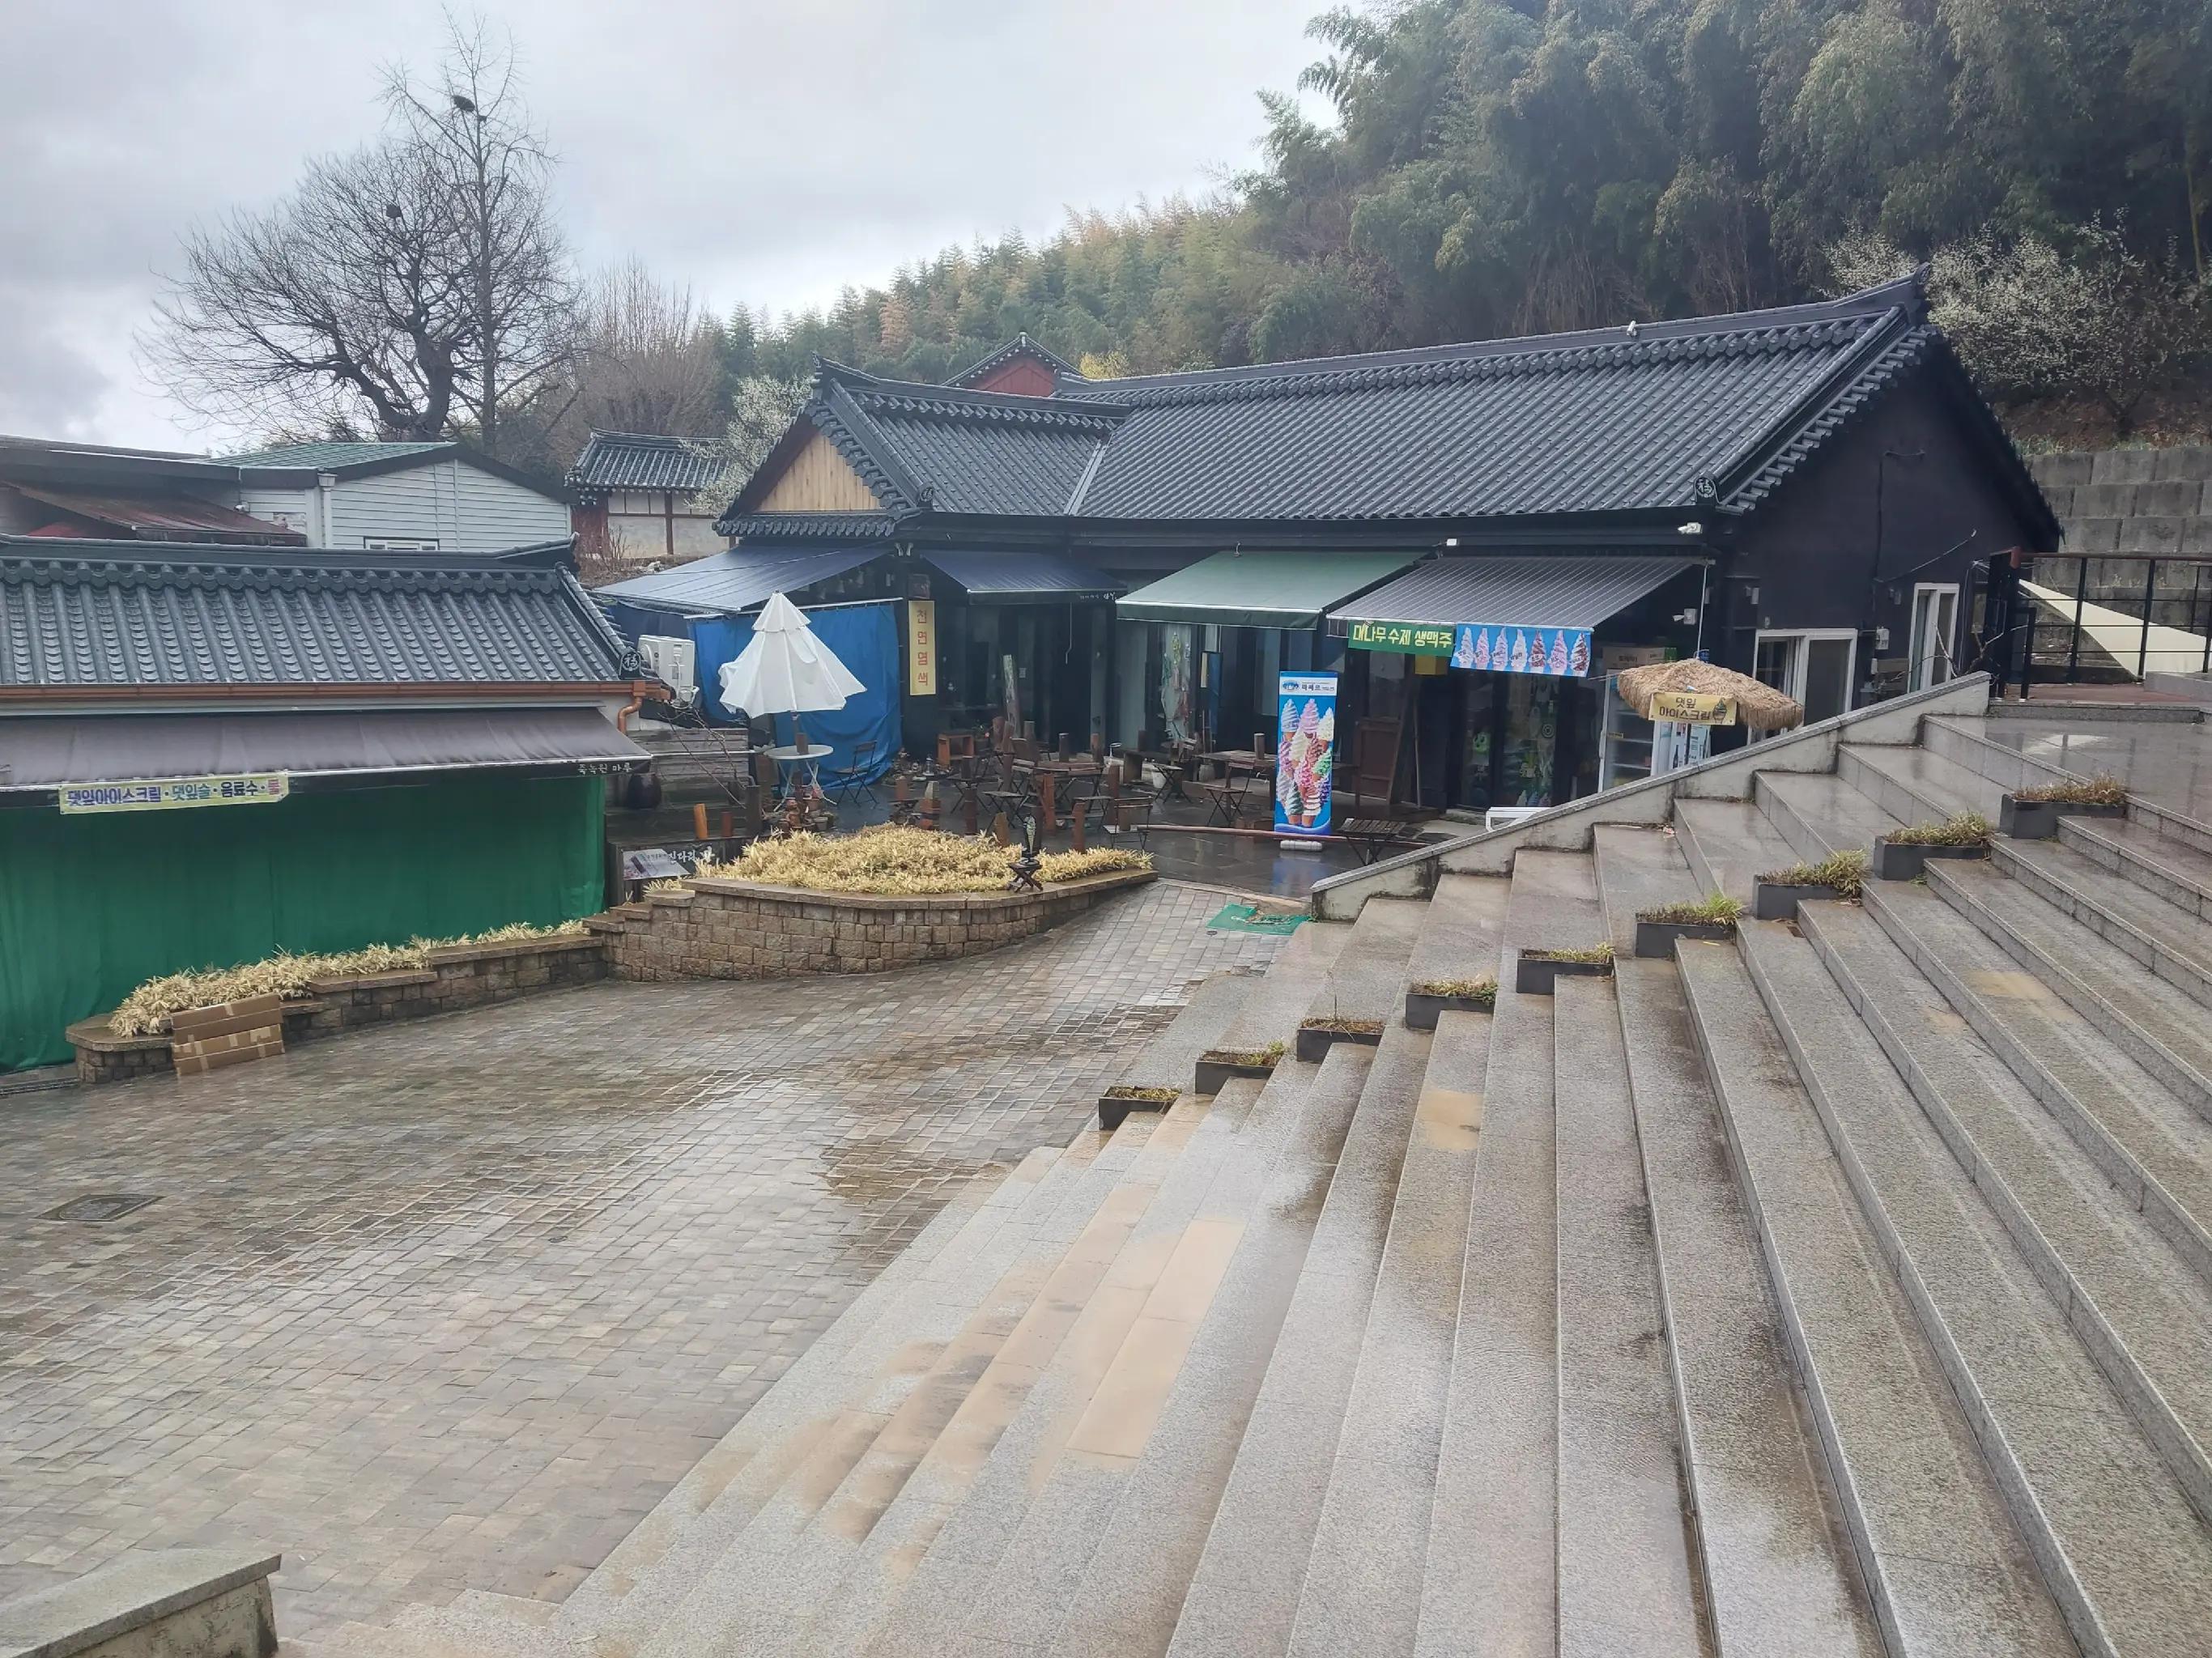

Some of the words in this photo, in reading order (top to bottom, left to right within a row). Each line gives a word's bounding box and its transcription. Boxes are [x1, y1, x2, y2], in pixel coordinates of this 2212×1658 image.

[1352, 623, 1387, 643] 대나무
[1387, 628, 1413, 646] 수제
[1414, 630, 1453, 648] 생맥주
[917, 609, 929, 687] 천연염색
[1675, 696, 1697, 709] 댓잎
[1659, 706, 1712, 721] 아이스크림
[577, 763, 608, 776] 죽녹원
[612, 762, 632, 773] 마루
[220, 780, 259, 798] 음료수
